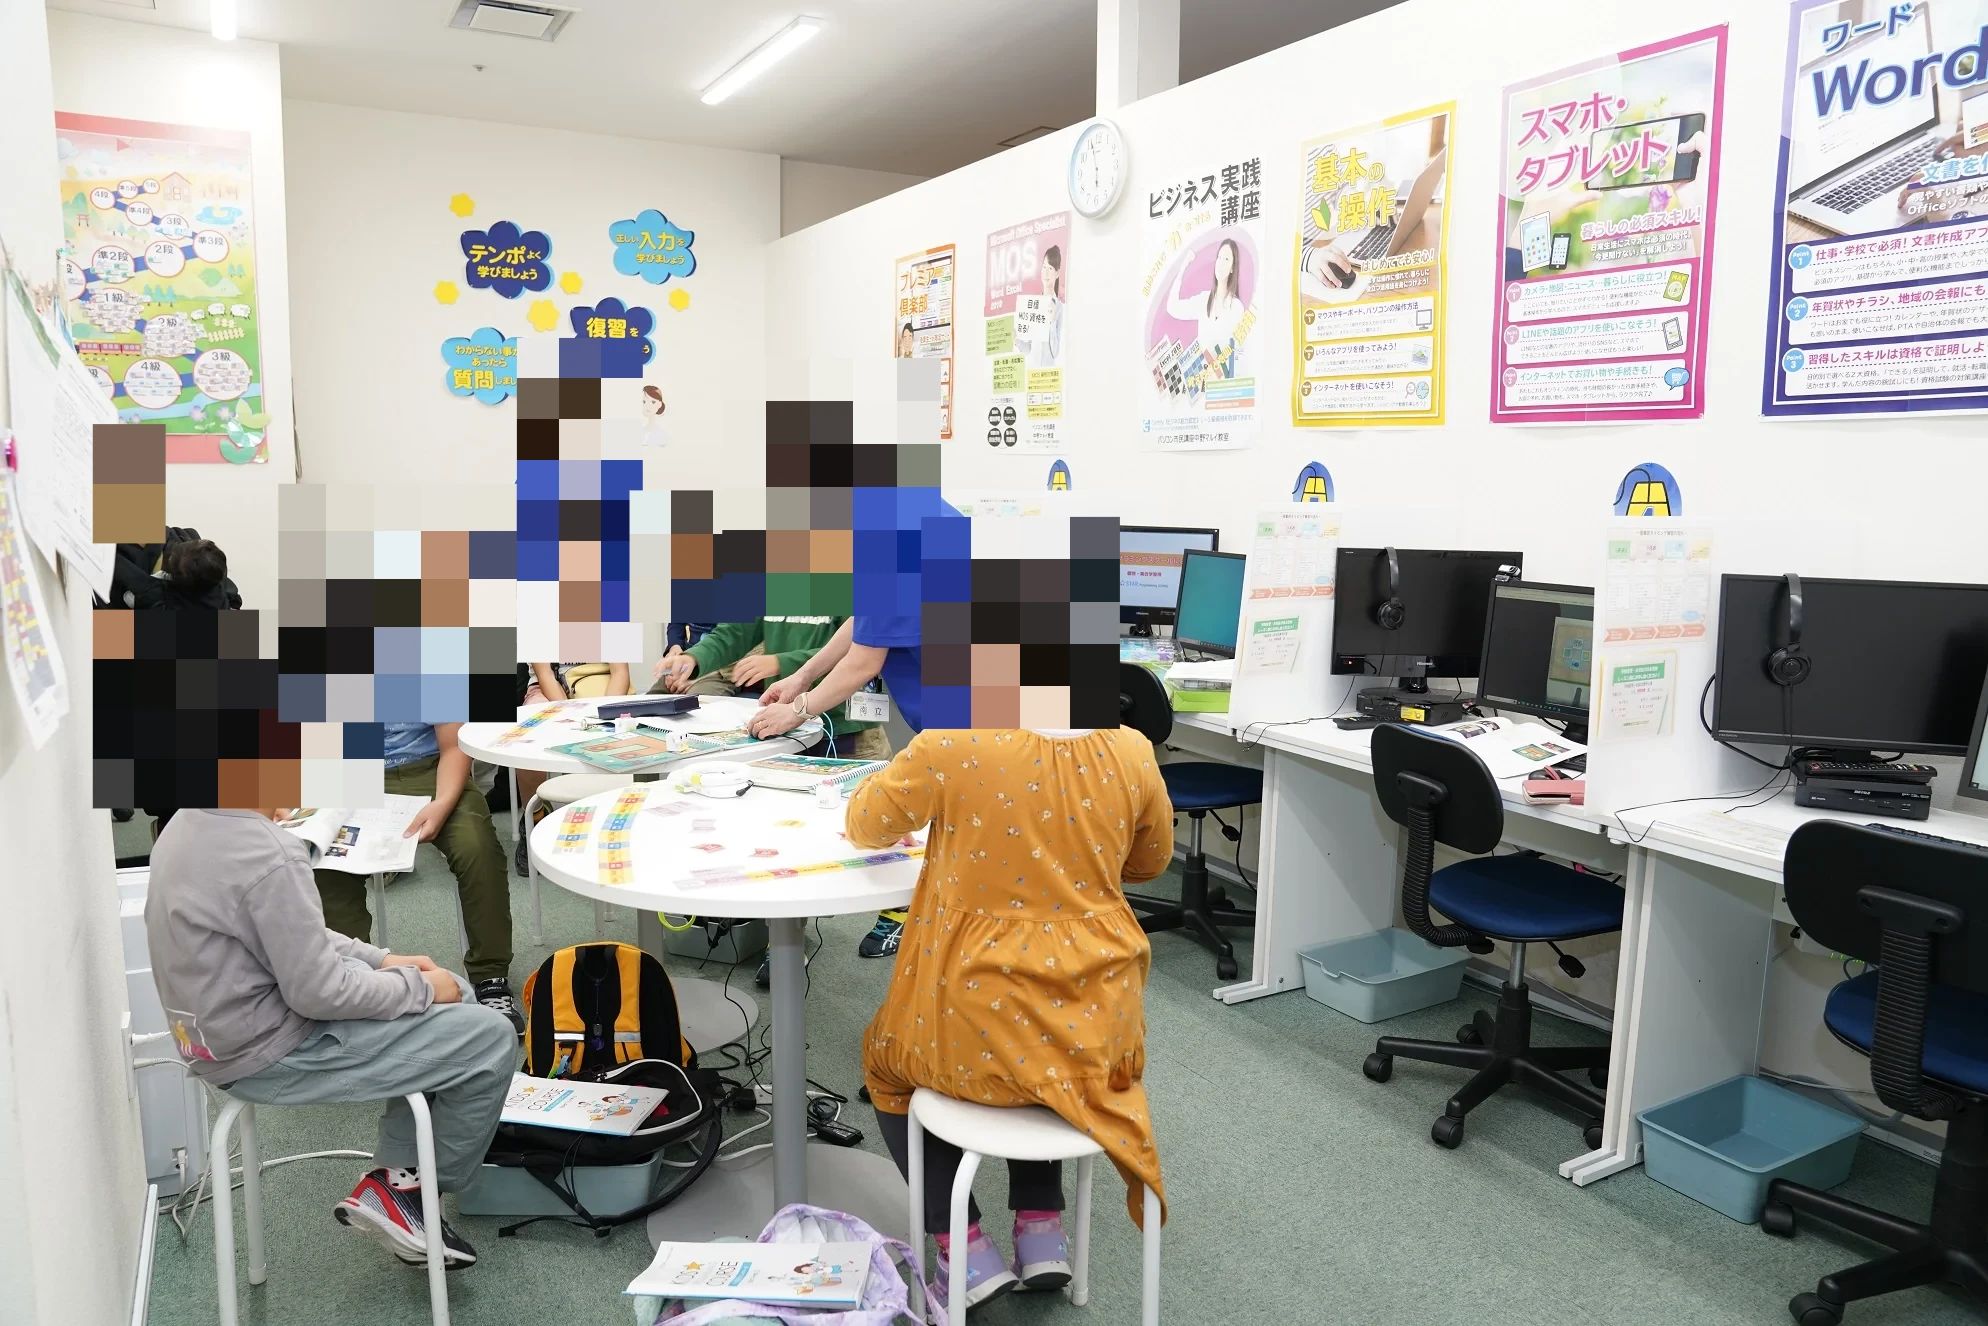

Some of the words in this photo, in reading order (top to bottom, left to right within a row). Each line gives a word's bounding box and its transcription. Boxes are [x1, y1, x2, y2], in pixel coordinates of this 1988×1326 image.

[1822, 3, 1914, 52] ワード
[1810, 25, 1988, 117] Word
[1517, 92, 1627, 148] スマホ・
[1311, 147, 1385, 193] 基本の
[1515, 131, 1670, 193] タブレット
[1149, 174, 1219, 220] ビジネス
[1220, 157, 1261, 195] 実践
[1220, 190, 1261, 228] 講座
[1336, 186, 1397, 234] 操作
[155, 244, 174, 254] 2段
[199, 237, 224, 245] 準3段
[615, 231, 685, 251] 正しい入力を
[98, 251, 129, 262] 準2段
[469, 245, 541, 264] テンポよく
[636, 254, 685, 265] 学びましょう
[991, 240, 1037, 289] MOS
[477, 266, 538, 280] 学びましょう
[1812, 285, 1985, 312] 年賀状やチラシ、地域の会報にも
[586, 318, 639, 339] 復習を
[212, 352, 230, 361] 3級
[472, 358, 507, 367] あったら
[1808, 342, 1988, 364] 習得したスキルは資格で証明しよ
[141, 361, 160, 371] 4級
[1314, 382, 1394, 391] インターネットを使いこなそう!
